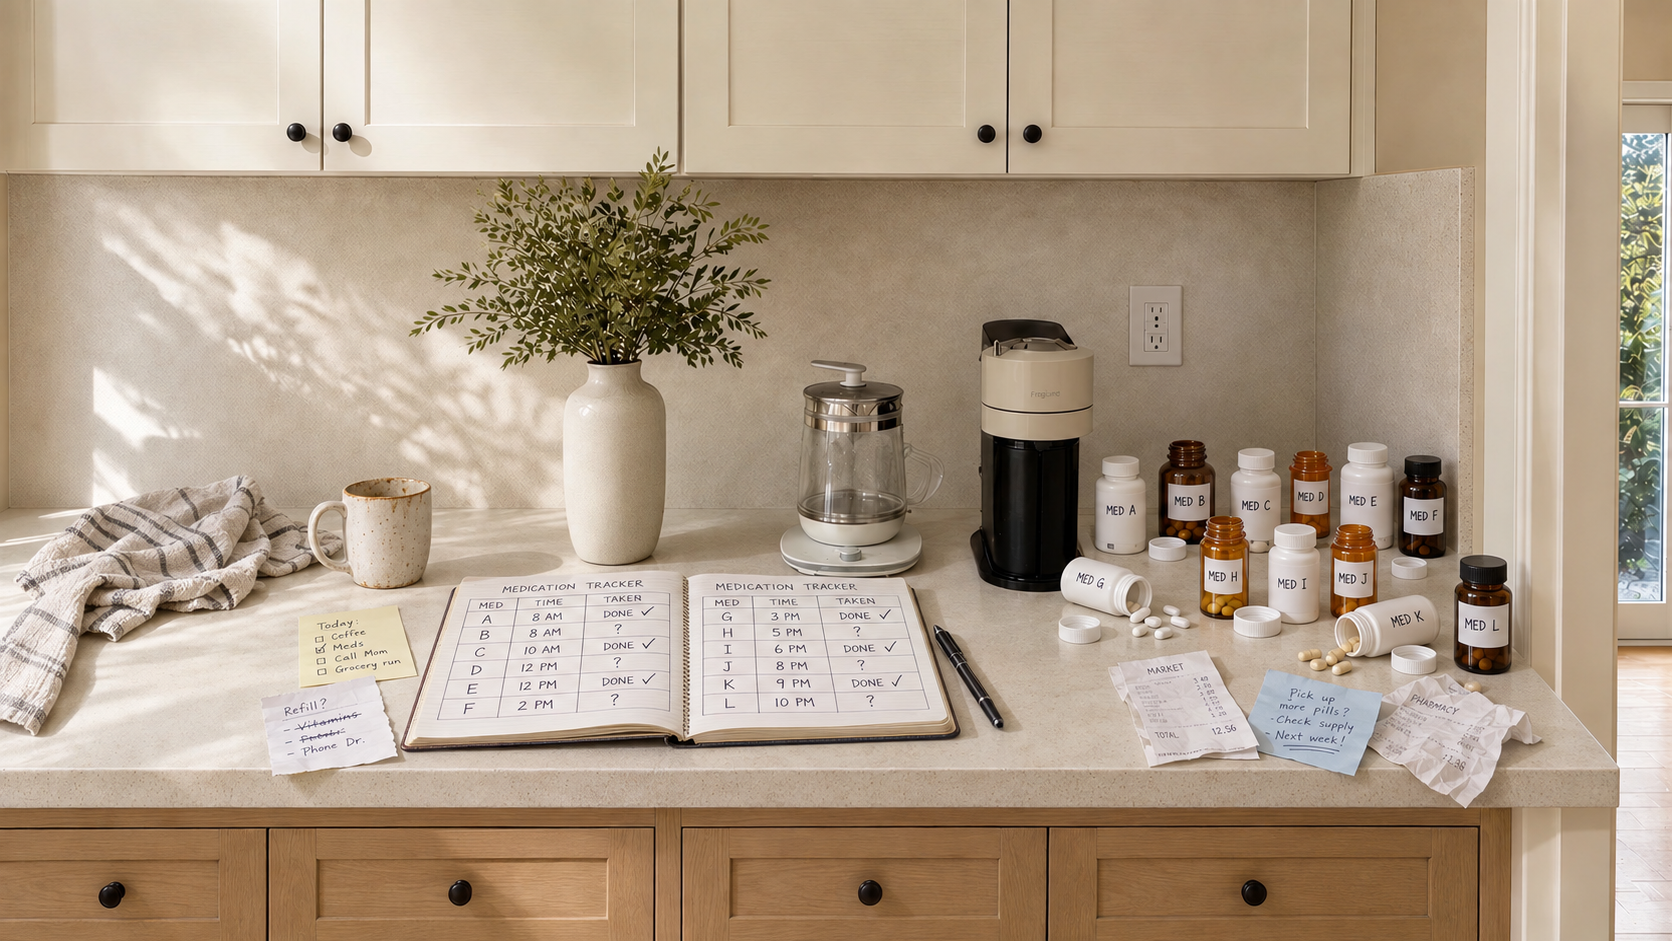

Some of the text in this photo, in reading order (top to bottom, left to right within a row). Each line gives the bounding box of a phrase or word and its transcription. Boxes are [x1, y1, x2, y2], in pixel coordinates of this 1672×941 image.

[1175, 495, 1205, 506] MED B
[1298, 492, 1324, 502] MED D
[1349, 495, 1377, 506] MED E
[1106, 505, 1136, 515] MED A
[1242, 500, 1270, 511] MED C
[1410, 510, 1438, 521] MED F
[1076, 573, 1105, 589] MED G
[1209, 571, 1237, 582] MED H
[1339, 573, 1367, 584] MED J
[502, 580, 643, 593] MEDICATION TRACKER
[1278, 578, 1306, 589] MED I
[536, 598, 562, 606] TIME
[532, 613, 540, 621] 8
[604, 609, 633, 618] DONE
[722, 612, 732, 621] G
[771, 612, 778, 621] 3
[840, 612, 870, 620] DONE
[1391, 610, 1424, 628] MED K
[318, 619, 358, 631] Today:
[482, 615, 491, 624] A
[1465, 618, 1499, 631] MED L
[529, 628, 561, 638] 8 AM
[615, 624, 622, 634] ?
[723, 628, 733, 638] H
[773, 628, 802, 637] 5 PM
[853, 626, 860, 637] ?
[332, 629, 366, 641] Coffee
[480, 630, 489, 640] B
[333, 641, 363, 651] Meds
[524, 645, 560, 655] 10 AM
[604, 642, 634, 651] DONE
[724, 645, 732, 654] I
[775, 645, 806, 653] 6 PM
[844, 644, 875, 653] DONE
[335, 652, 356, 662] Call
[475, 647, 485, 657] C
[335, 661, 377, 673] Grocery
[522, 662, 557, 672] 12 PM
[614, 657, 621, 668] ?
[723, 661, 732, 672] J
[777, 661, 808, 670] 8 PM
[857, 660, 864, 670] ?
[471, 665, 482, 675] D
[1147, 663, 1183, 675] MARKET
[520, 680, 556, 691] 12 PM
[603, 676, 633, 686] DONE
[724, 679, 734, 690] K
[777, 679, 810, 689] 9 PM
[852, 678, 883, 688] DONE
[467, 683, 478, 694] E
[611, 694, 619, 705] ?
[866, 695, 874, 707] ?
[1290, 688, 1335, 705] Pick up
[284, 698, 327, 716] Refill?
[518, 700, 553, 711] 2 PM
[725, 698, 735, 708] L
[776, 698, 815, 707] 10 PM
[1409, 694, 1460, 717] PHARMACY
[464, 703, 475, 714] F
[1313, 706, 1350, 717] pills?
[1212, 724, 1236, 735] 12.56
[1277, 715, 1311, 725] Check
[1319, 721, 1354, 734] supply
[1275, 730, 1303, 741] Next
[1309, 735, 1345, 747] week!
[301, 744, 337, 756] Phone
[346, 738, 365, 746] Dr.
